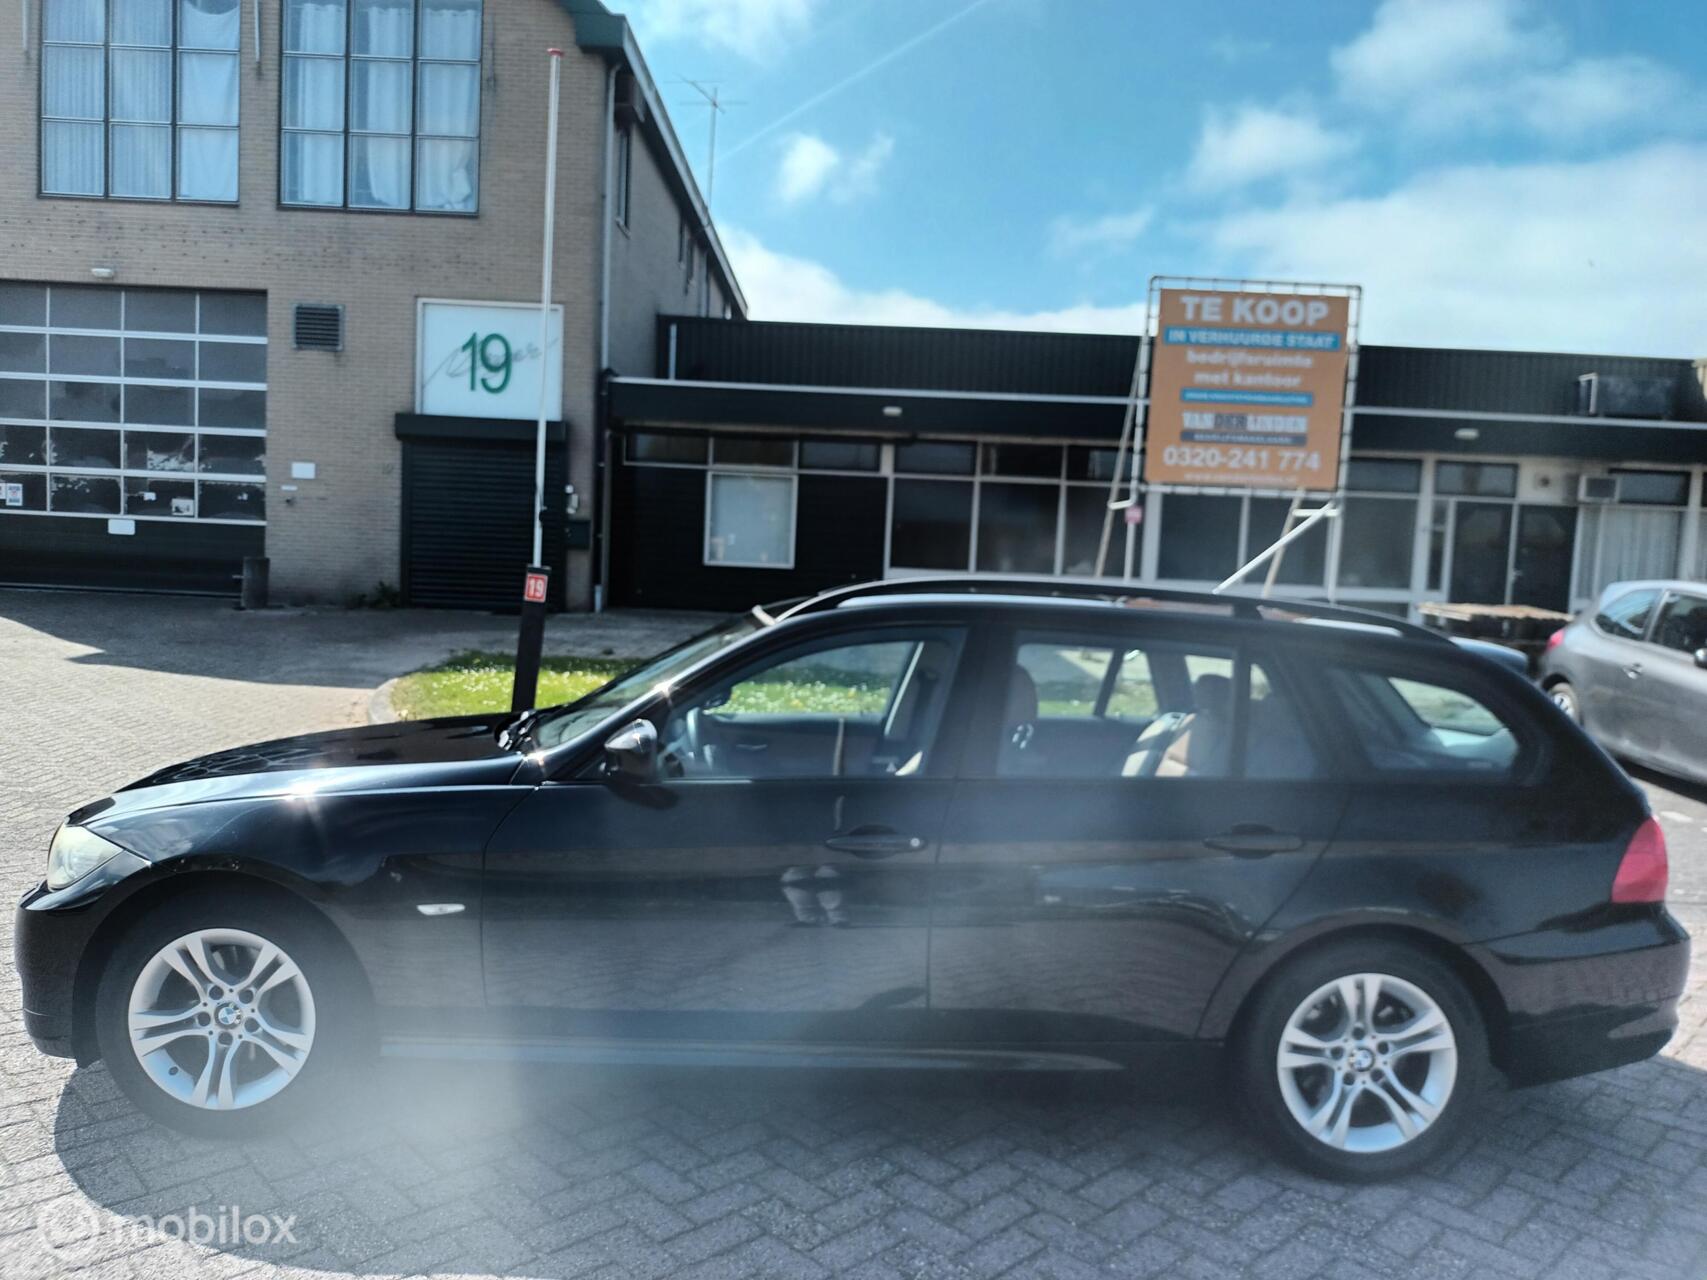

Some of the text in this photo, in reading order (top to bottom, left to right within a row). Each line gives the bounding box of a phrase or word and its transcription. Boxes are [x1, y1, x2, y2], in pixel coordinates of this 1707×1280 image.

[1180, 296, 1328, 326] TE KOOP
[1168, 329, 1335, 348] IN VERHUURDE STAAT
[462, 332, 512, 394] 19
[1278, 451, 1321, 471] 774
[528, 578, 545, 598] 19
